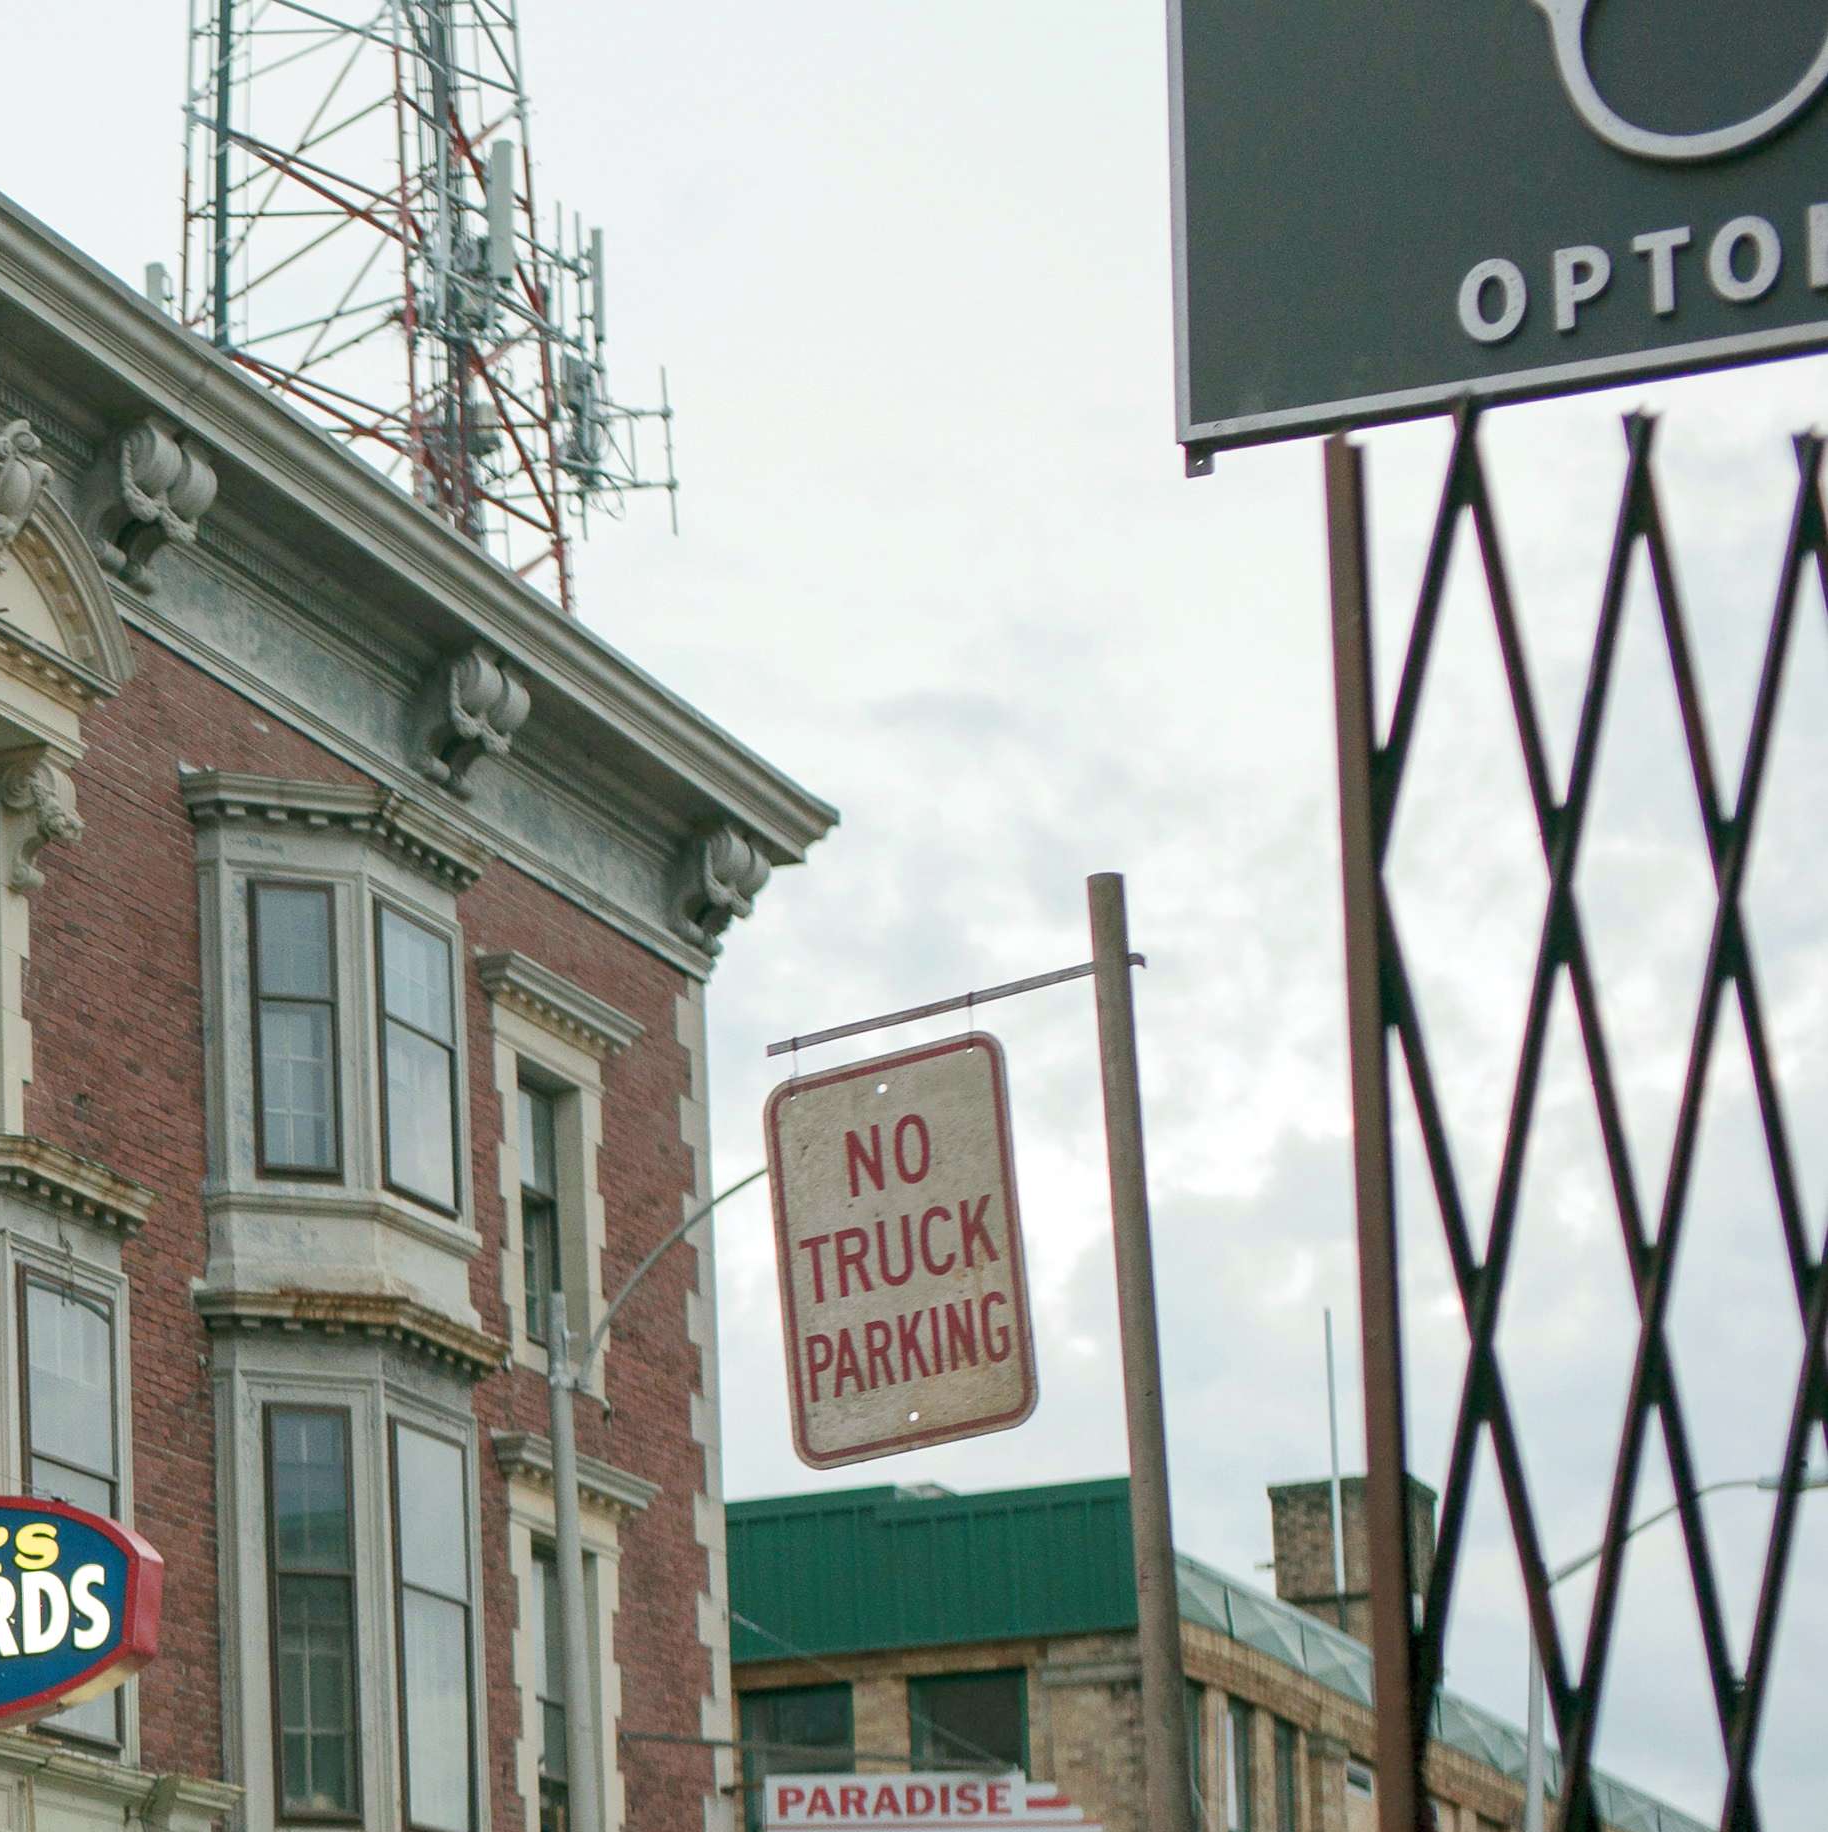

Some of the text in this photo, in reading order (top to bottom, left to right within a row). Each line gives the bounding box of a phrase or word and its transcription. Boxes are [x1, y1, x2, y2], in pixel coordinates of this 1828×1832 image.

[845, 1113, 931, 1197] NO
[798, 1193, 1000, 1304] TRUCK
[805, 1291, 1011, 1402] PARKING
[776, 1782, 1013, 1819] PARADISE
